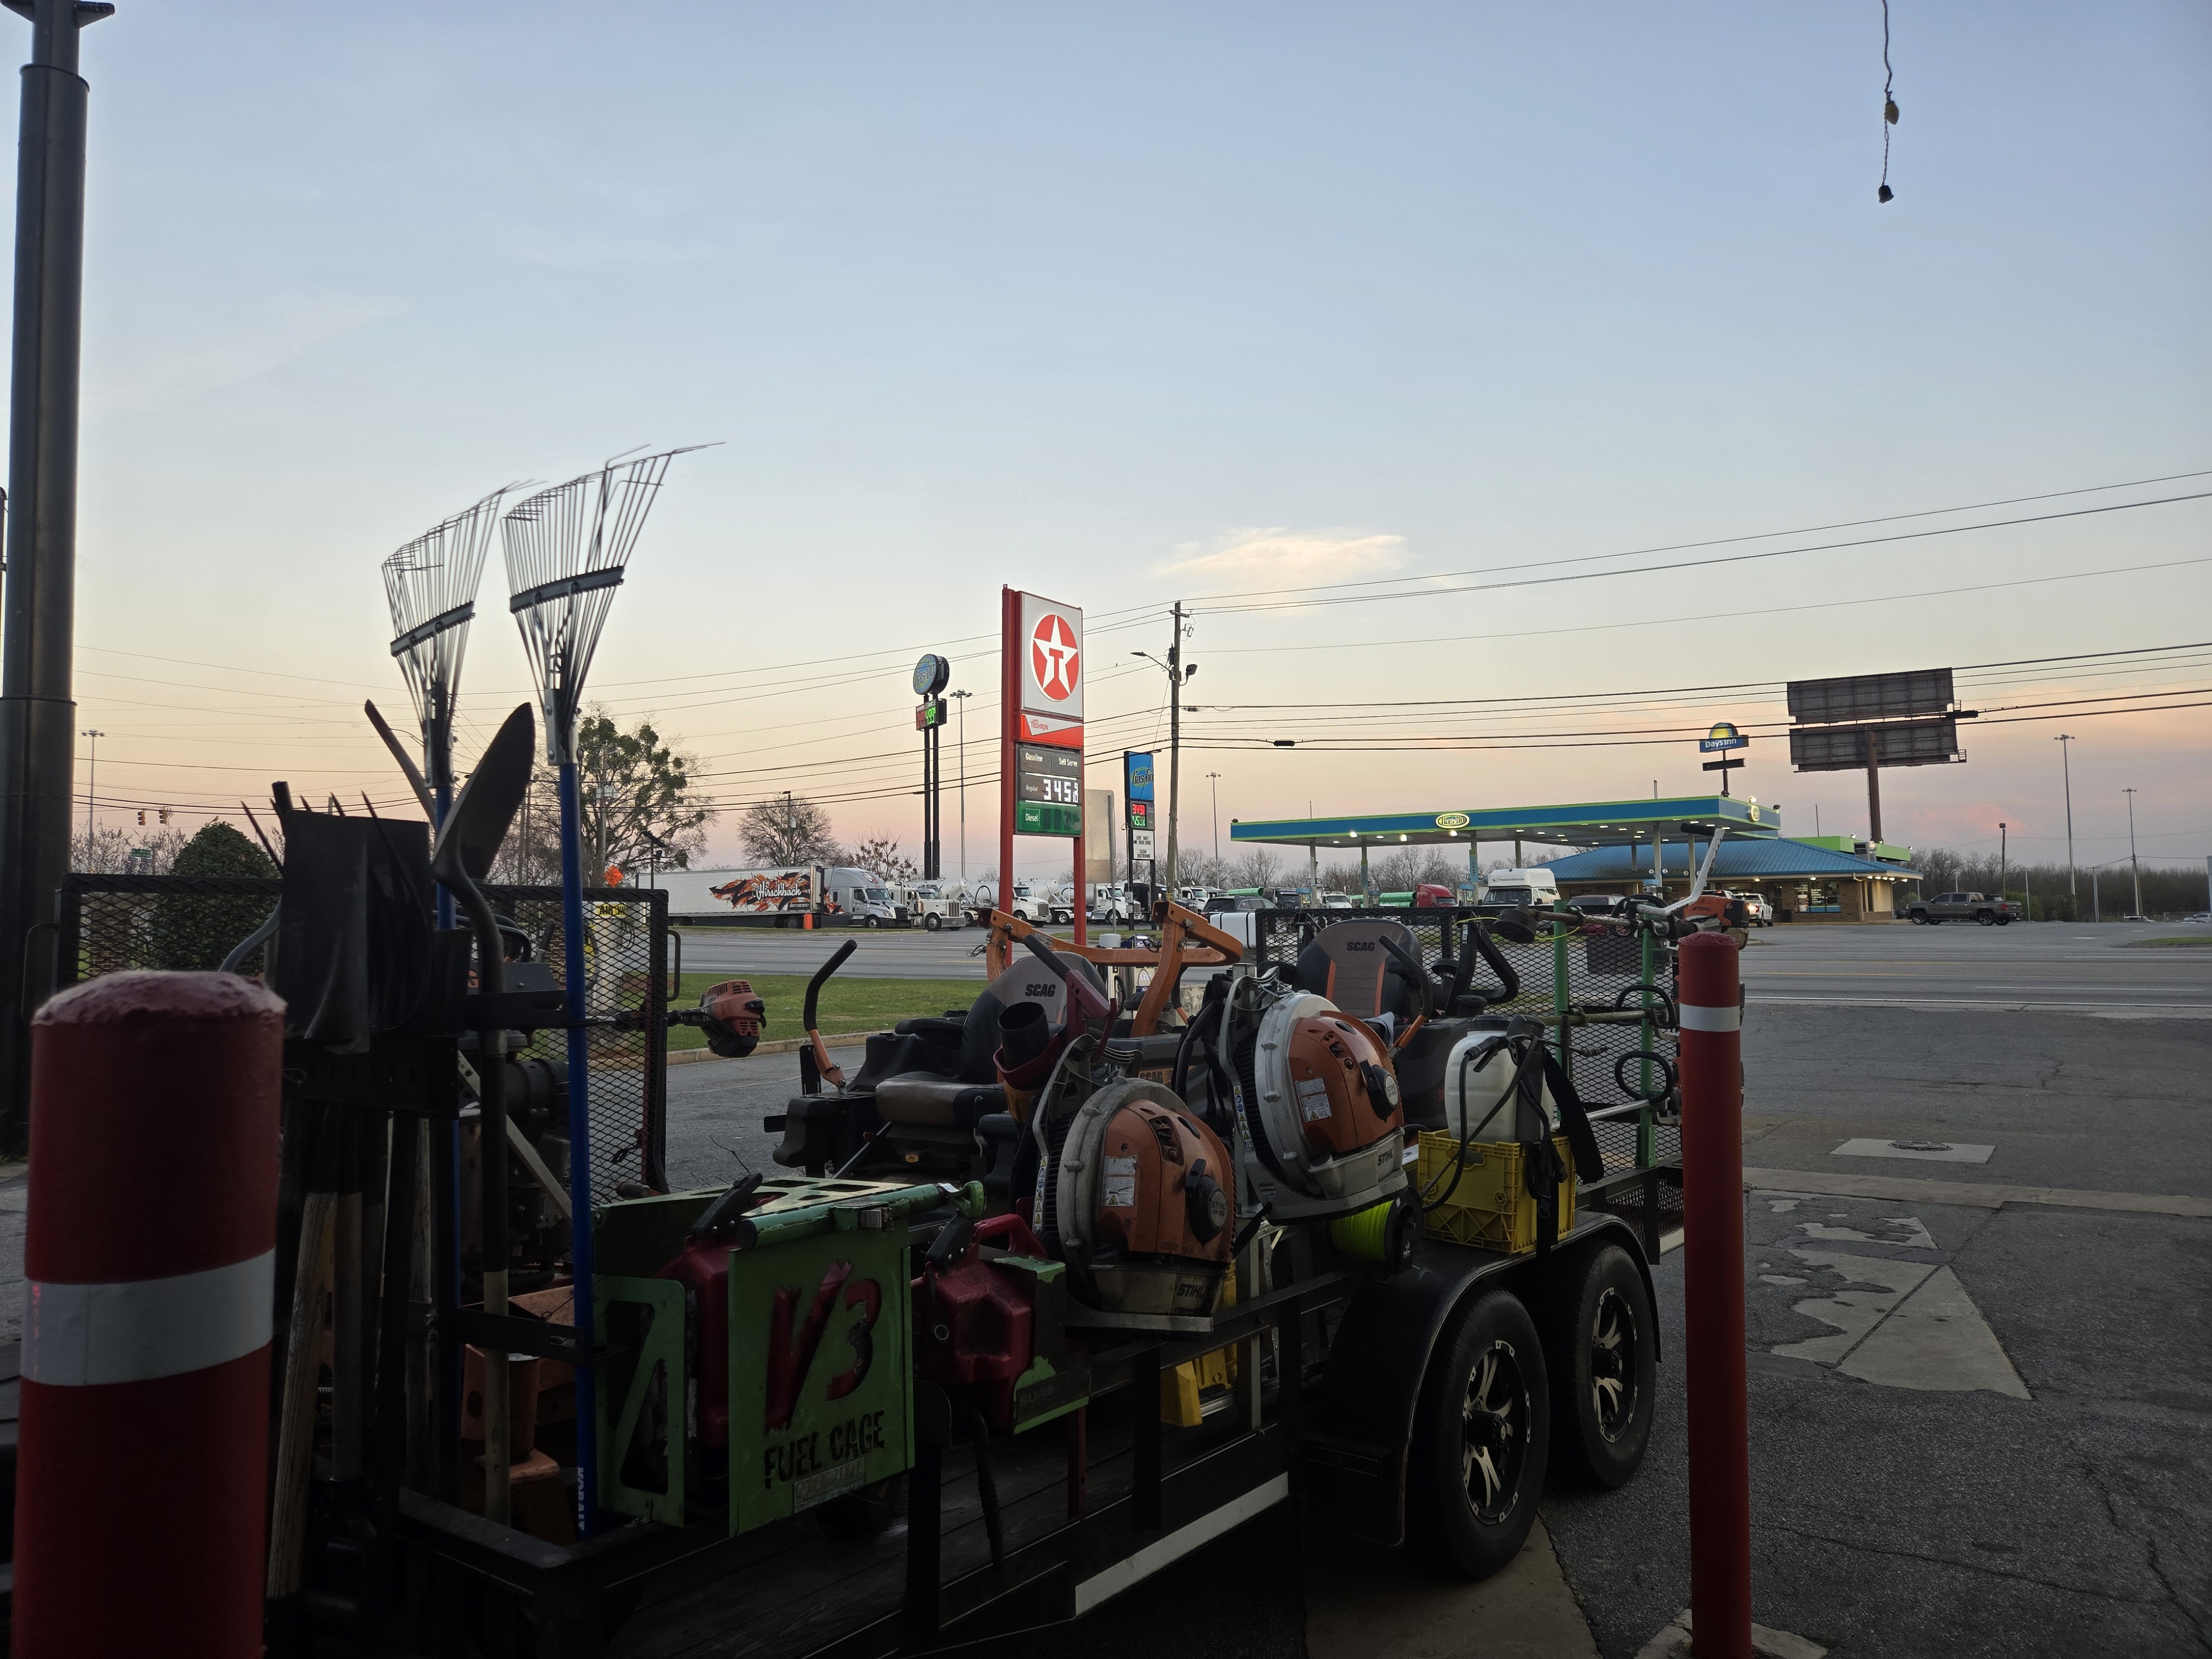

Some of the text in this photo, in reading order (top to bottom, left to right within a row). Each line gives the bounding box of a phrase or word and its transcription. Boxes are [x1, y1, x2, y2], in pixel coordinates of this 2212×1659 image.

[1031, 721, 1048, 731] TECHRON
[1025, 753, 1043, 762] Gasoline
[1067, 759, 1078, 767] Serve
[1133, 769, 1153, 784] Gas Go
[1025, 813, 1039, 822] Diesel
[756, 880, 802, 900] Hirschbach
[1346, 942, 1375, 951] SCAG
[1025, 984, 1056, 997] SCAG
[1378, 1146, 1394, 1166] STIHL
[1211, 1202, 1225, 1211] STIHL
[1177, 1284, 1204, 1297] STIHL
[765, 1432, 822, 1490] FUEL
[830, 1411, 885, 1462] CAGE
